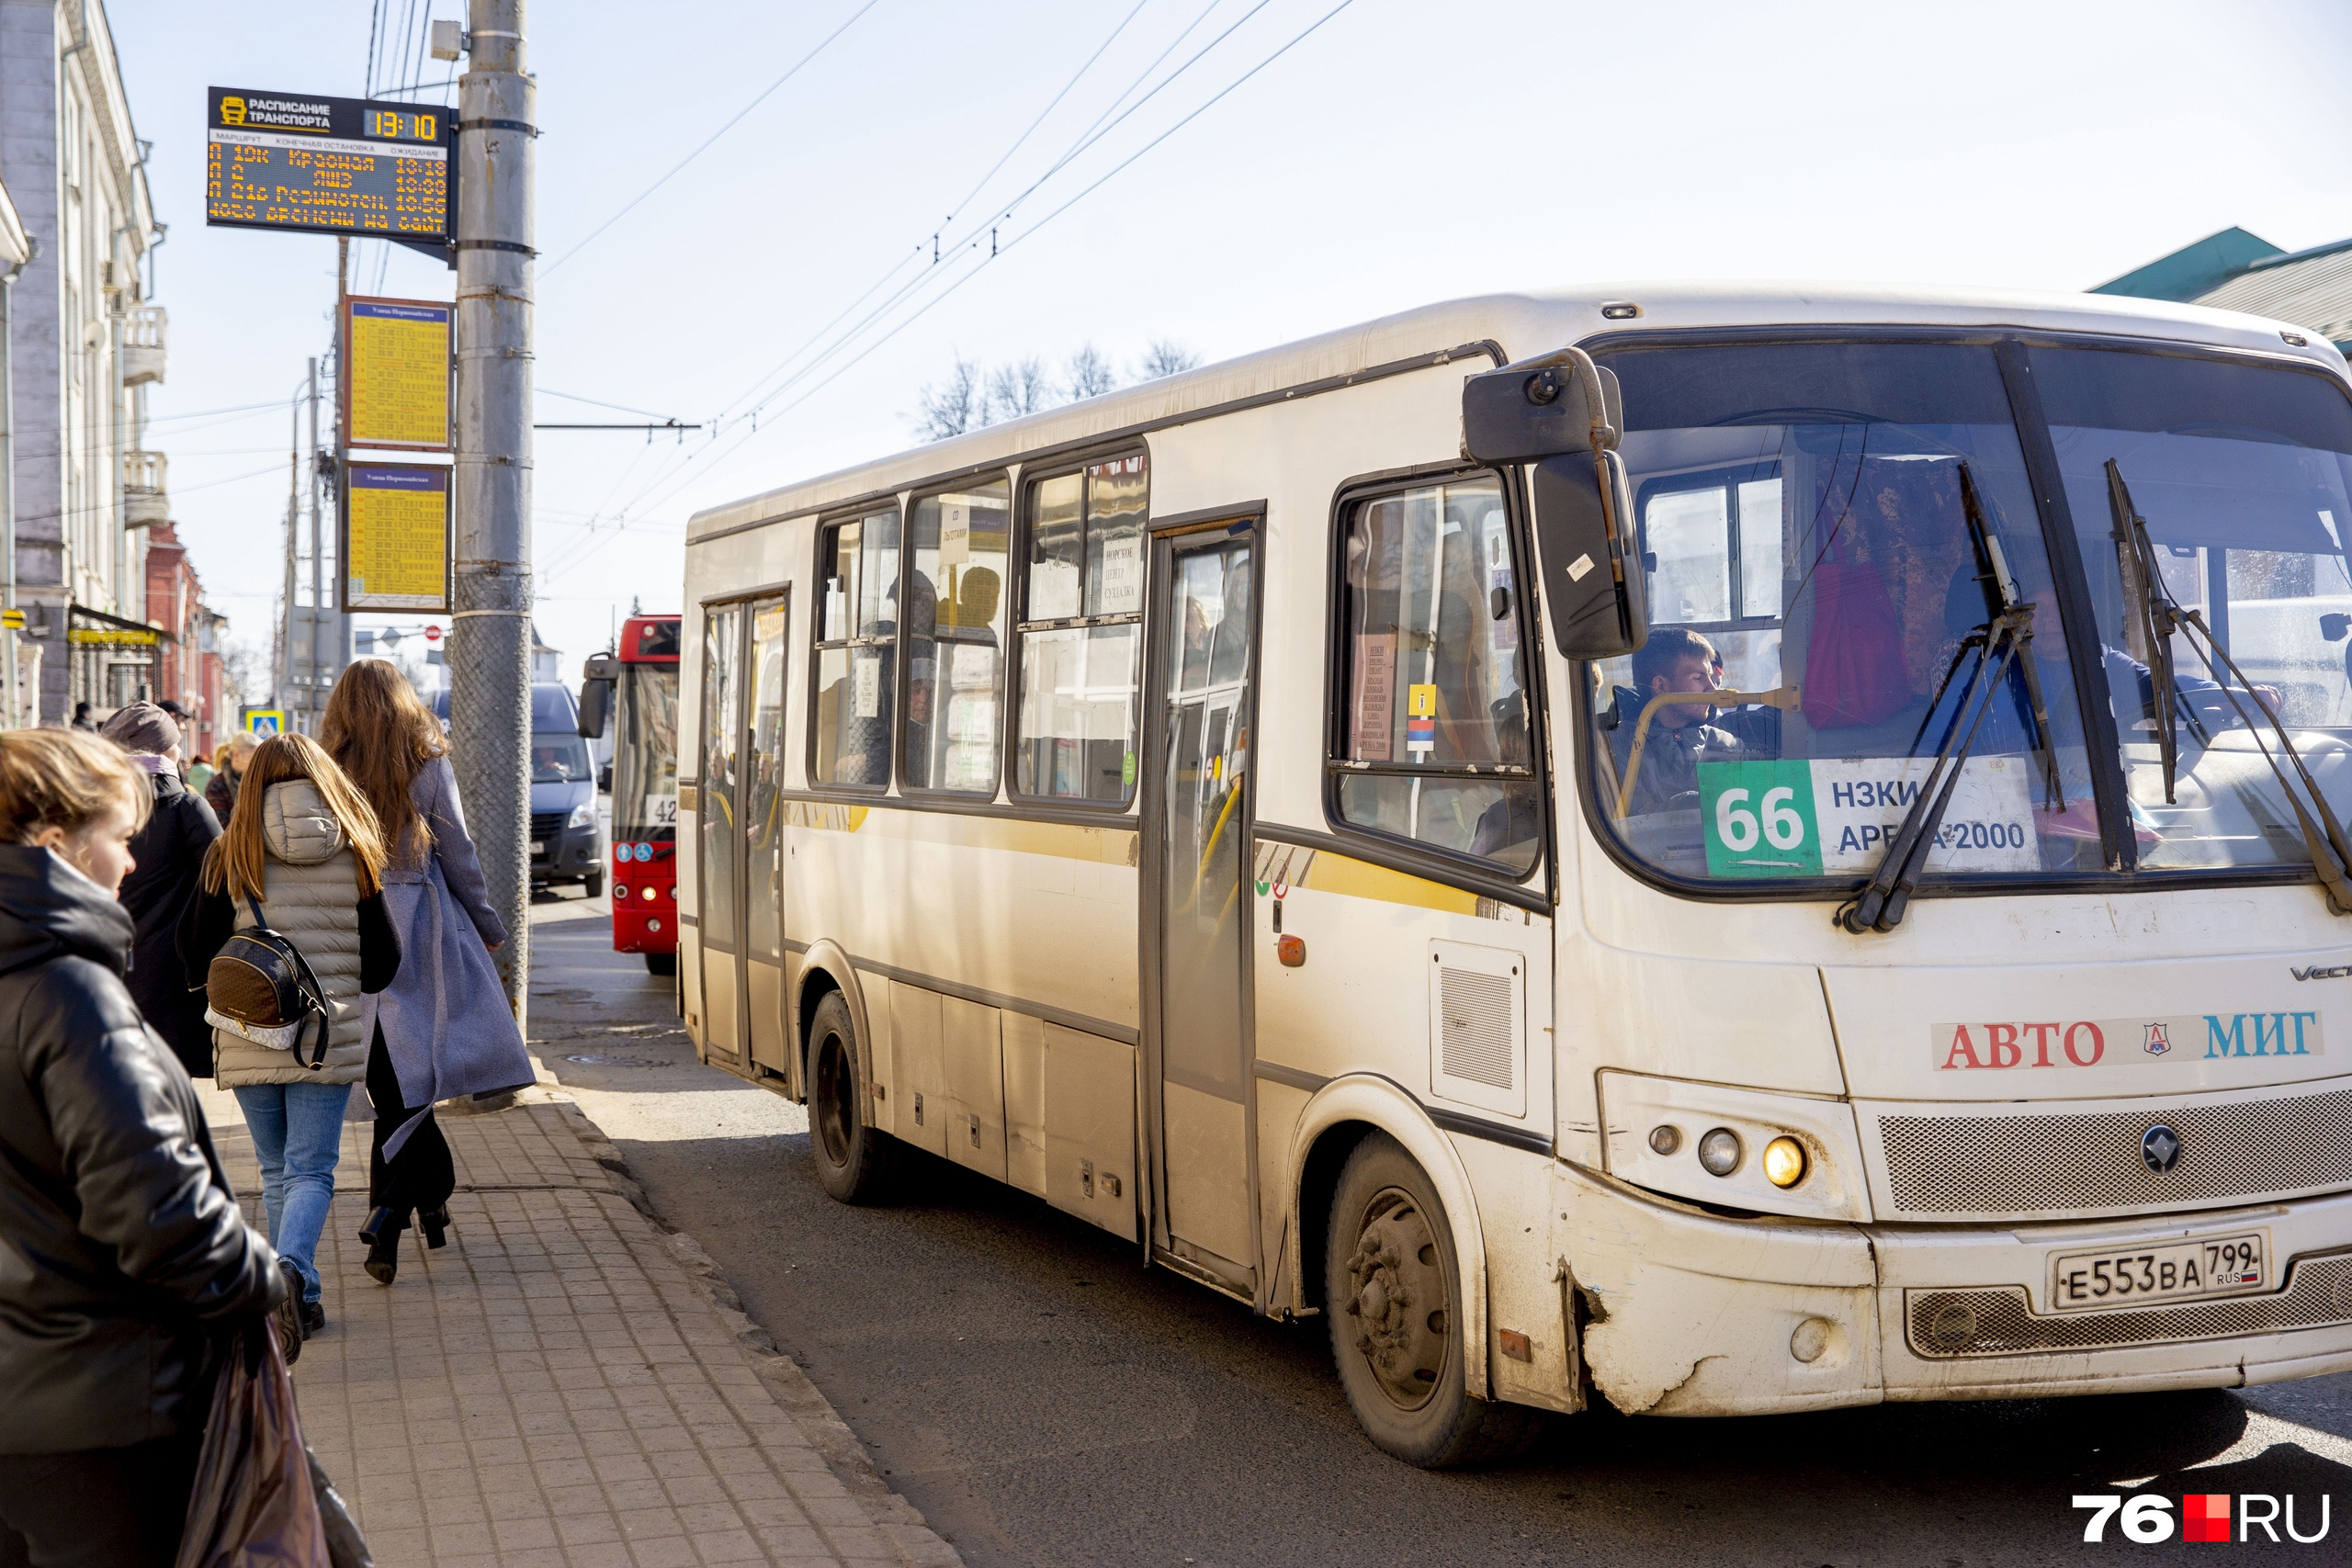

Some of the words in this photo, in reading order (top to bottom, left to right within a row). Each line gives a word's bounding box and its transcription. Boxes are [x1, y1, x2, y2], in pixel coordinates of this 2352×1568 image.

[248, 97, 331, 117] РАСПИСАНИЕ
[249, 110, 331, 129] ТРАНСПОРТА
[375, 111, 436, 141] 13:10
[216, 132, 261, 143] МАРШРУТ
[276, 137, 322, 149] КОНЕЧНАЯ
[323, 141, 376, 153] ОСТАНОВКА
[390, 147, 439, 159] ОЖИДАНИЕ
[232, 164, 244, 181] 2
[1106, 547, 1134, 562] НОРСКОЕ
[1105, 568, 1125, 581] ЦЕНТР
[1104, 585, 1135, 600] СУЗДАЛКА
[1832, 779, 1920, 808] НЗКИ
[1714, 785, 1805, 852] 66
[1940, 1020, 2105, 1071] АВТО
[2202, 1011, 2317, 1059] МИГ
[2069, 1255, 2201, 1300] Е553ВА
[2206, 1242, 2253, 1276] 799
[2217, 1271, 2241, 1285] RUS
